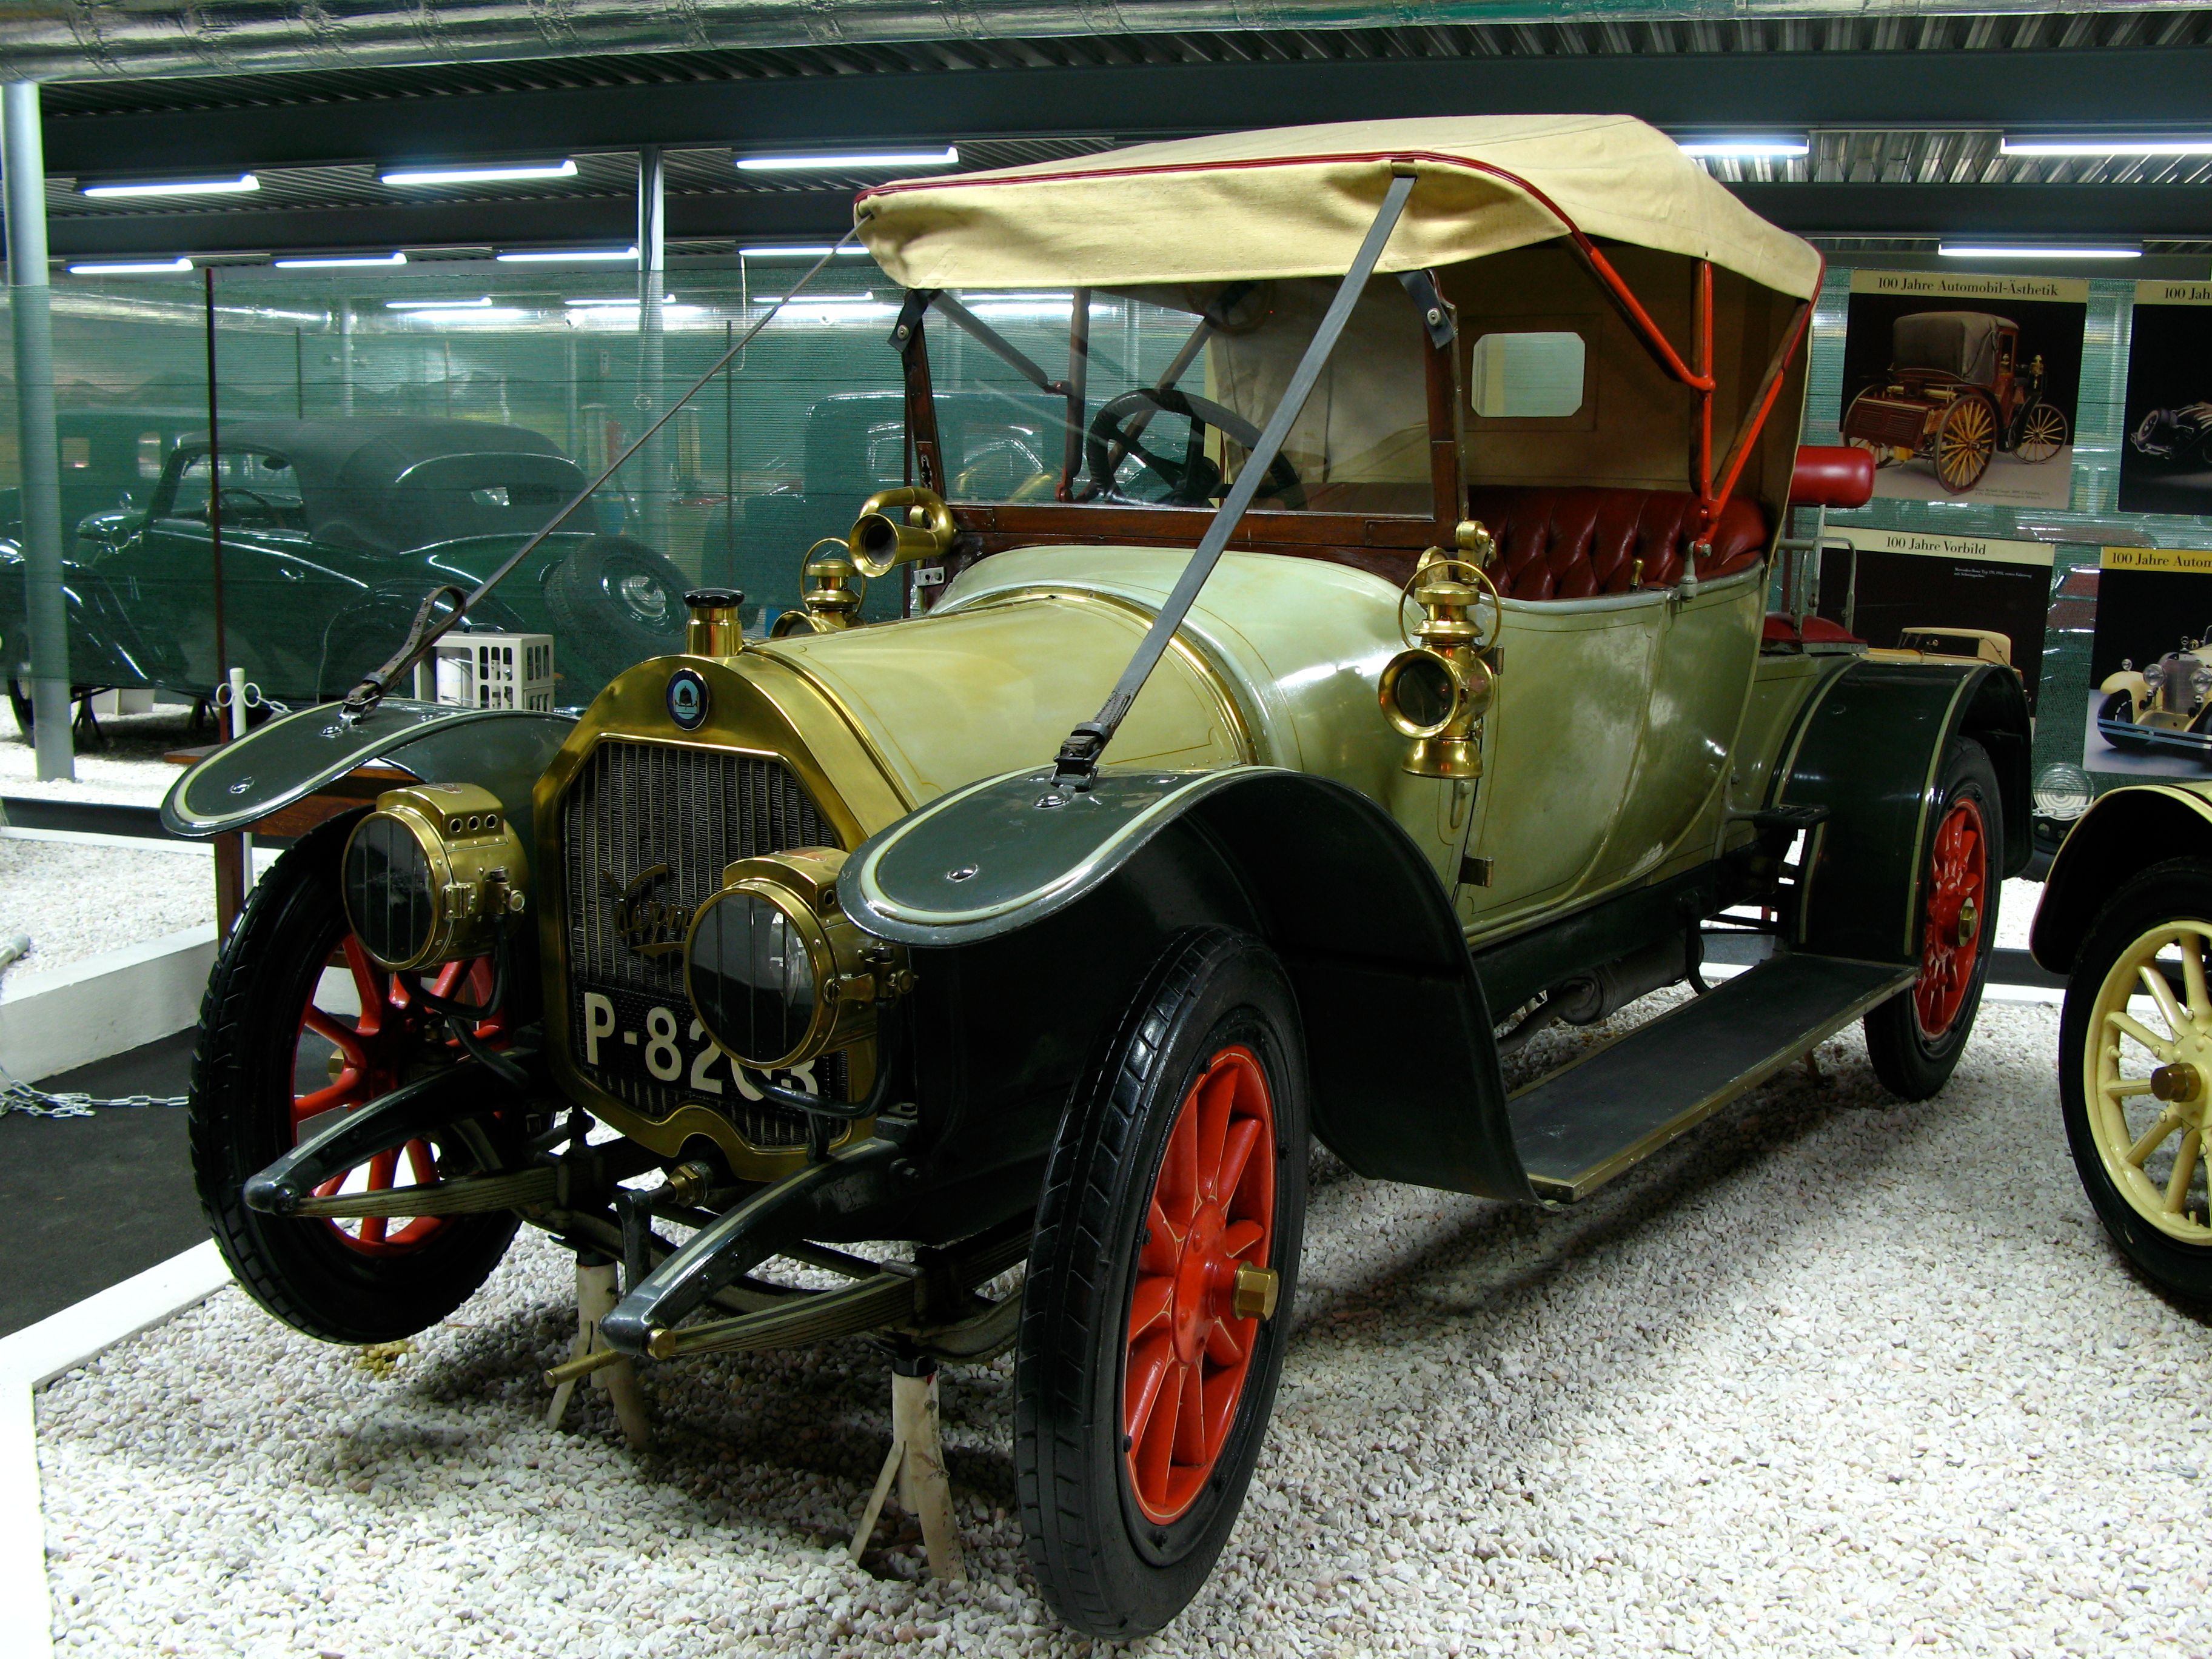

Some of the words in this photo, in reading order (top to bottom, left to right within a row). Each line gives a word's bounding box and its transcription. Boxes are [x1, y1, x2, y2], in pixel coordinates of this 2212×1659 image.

[1879, 277, 1898, 289] 100
[1901, 278, 1934, 291] Jahre
[1939, 280, 2059, 297] Automobil-Ästhetik
[2165, 287, 2185, 299] 100
[1887, 536, 1906, 549] 100
[1909, 538, 1940, 551] Jahre
[1944, 540, 1986, 555] Vorbild
[2113, 552, 2133, 564] 100
[2135, 553, 2169, 566] Jahre
